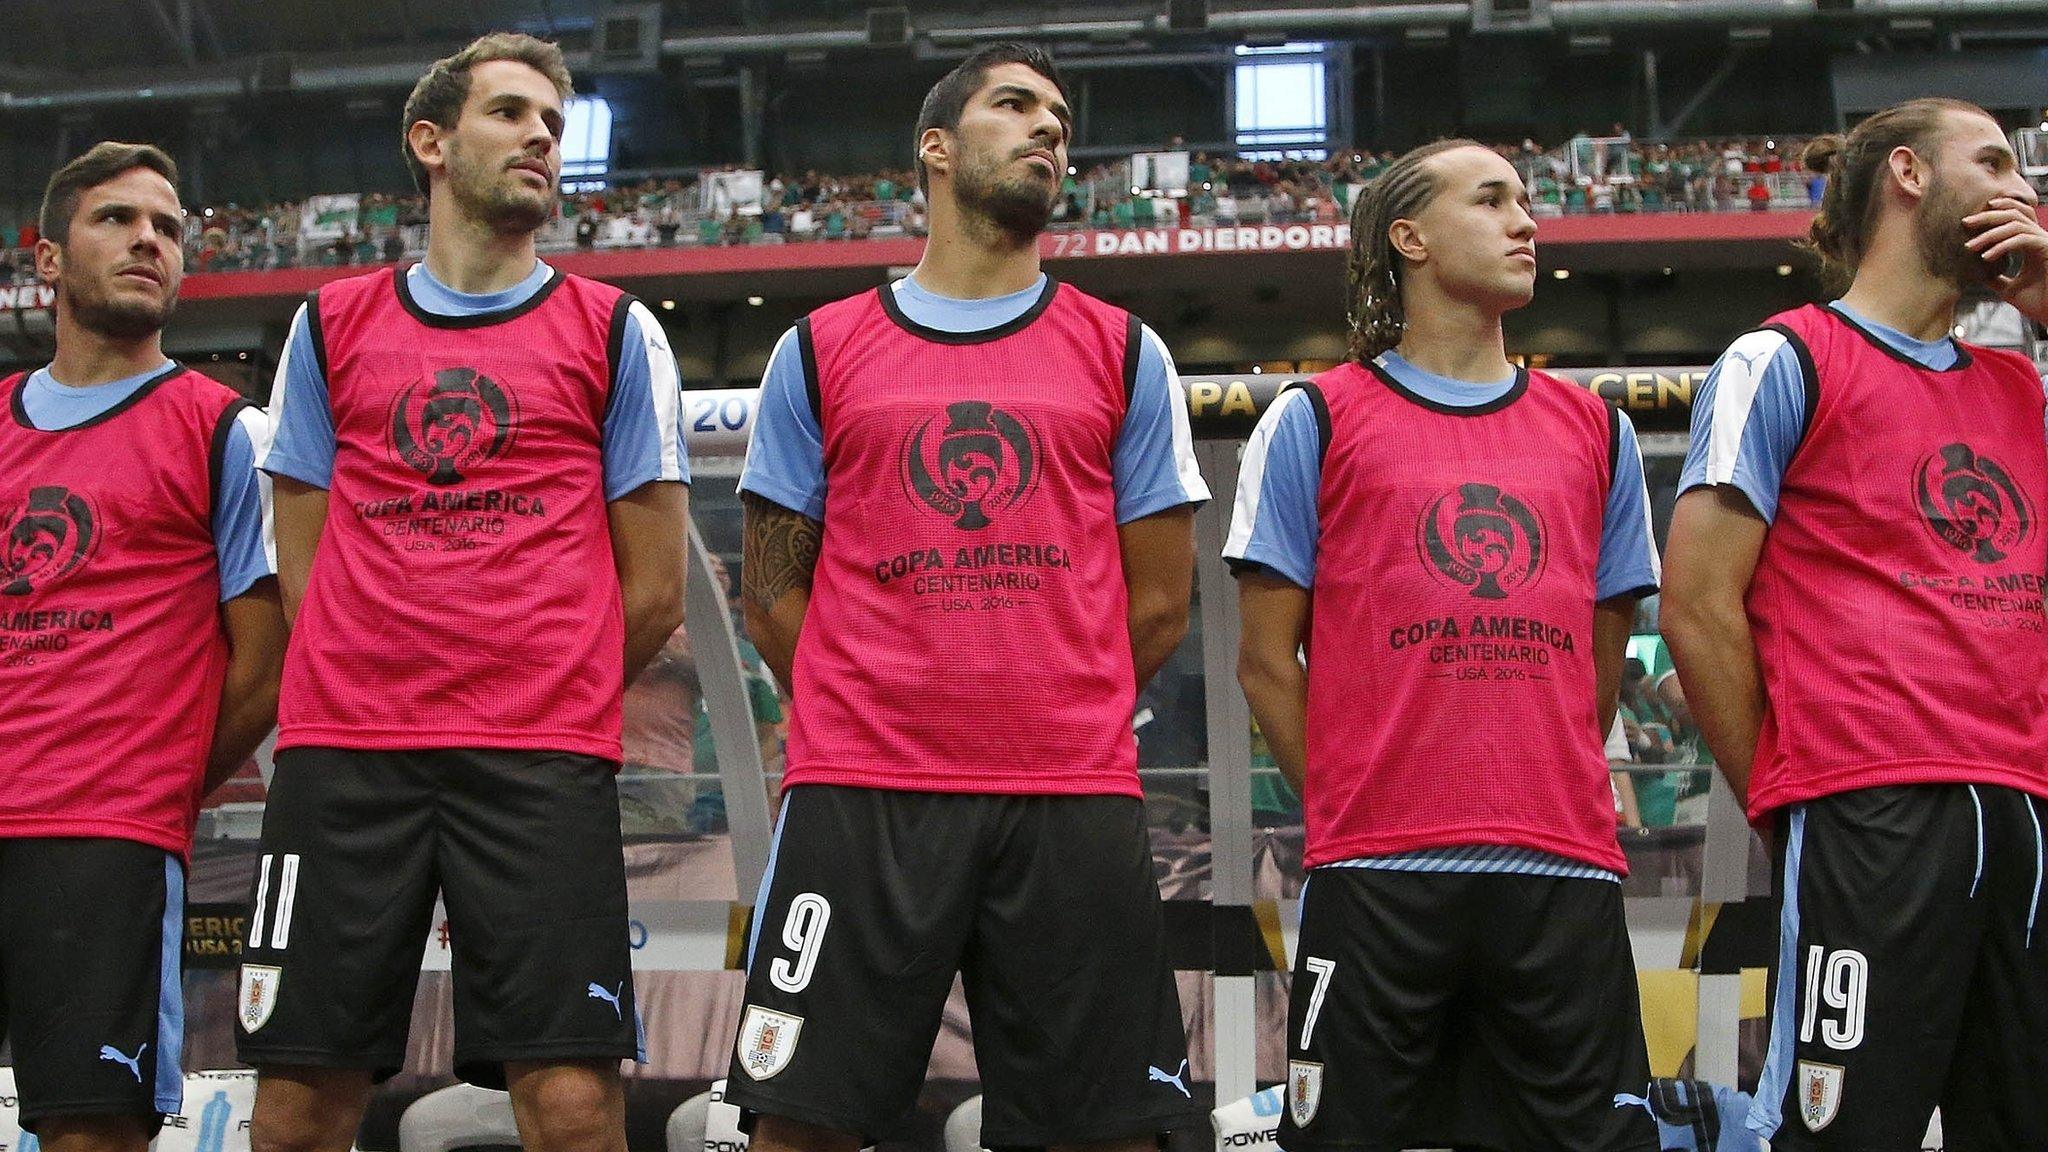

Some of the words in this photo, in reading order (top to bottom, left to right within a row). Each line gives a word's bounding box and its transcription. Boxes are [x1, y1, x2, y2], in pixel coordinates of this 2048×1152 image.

[1053, 234, 1088, 257] 72
[1095, 230, 1169, 255] DAN
[420, 490, 545, 518] AMERICA
[384, 517, 505, 537] CENTENARIO
[875, 547, 944, 585] COPA
[954, 543, 1073, 573] AMERICA
[914, 572, 1041, 596] CENTENARIO
[942, 598, 975, 611] USA
[981, 596, 1015, 610] 2016
[1389, 616, 1460, 650] COPA
[1469, 615, 1575, 655] AMERICA
[1430, 643, 1549, 666] CENTENARIO
[1457, 668, 1489, 681] USA
[1494, 668, 1526, 681] 2016
[249, 853, 301, 950] 11
[769, 892, 832, 994] 9
[1300, 956, 1337, 1051] 7
[1801, 945, 1869, 1051] 19
